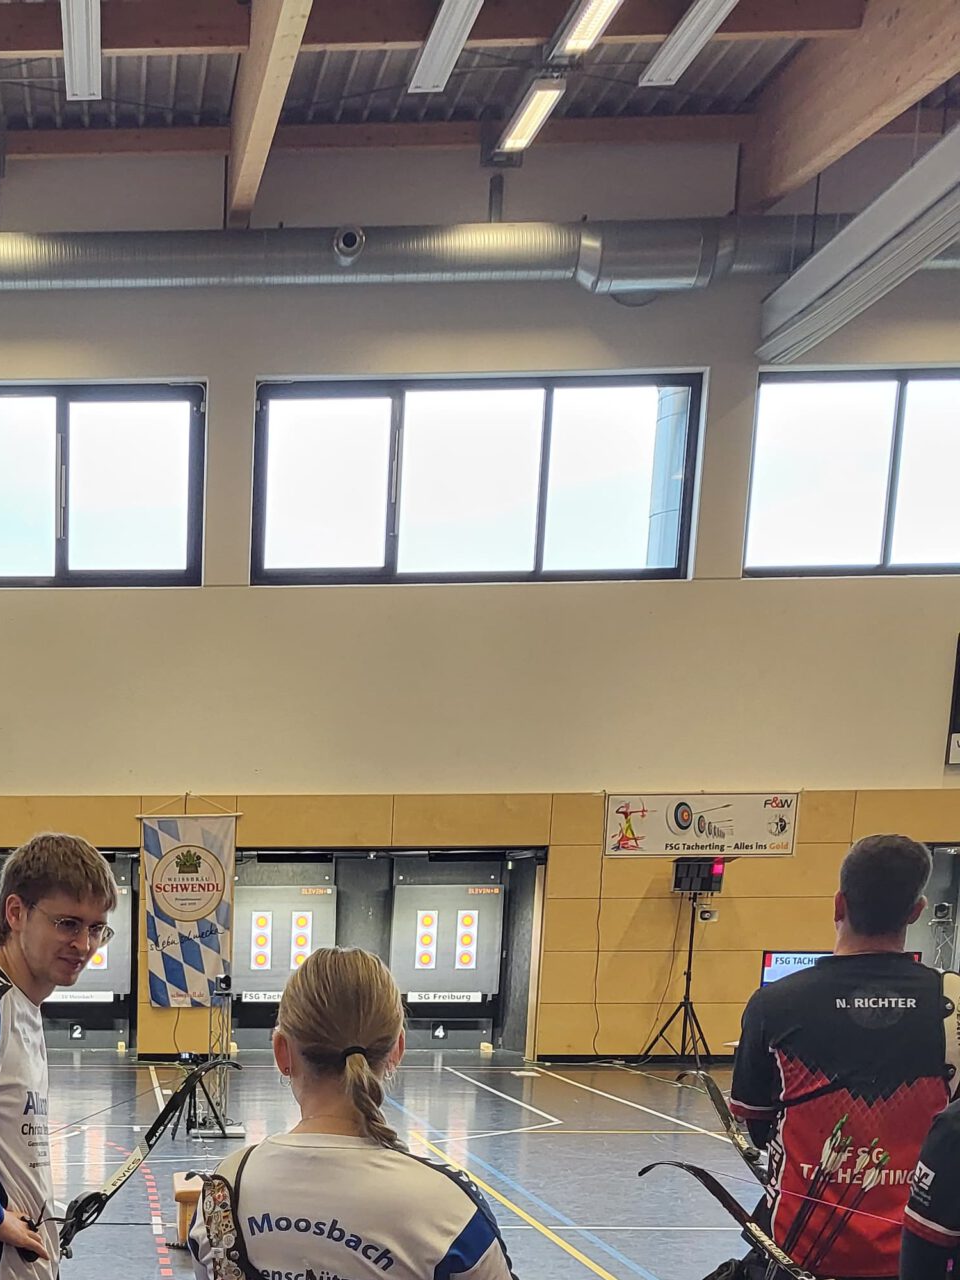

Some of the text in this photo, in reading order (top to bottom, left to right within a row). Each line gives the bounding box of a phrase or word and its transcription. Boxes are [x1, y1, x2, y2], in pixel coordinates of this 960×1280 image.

[763, 796, 793, 809] F&W
[664, 842, 680, 851] FSG
[682, 842, 725, 852] Tacherting
[734, 842, 754, 850] Alles
[755, 842, 767, 850] ins
[769, 842, 789, 850] Gold
[155, 882, 223, 893] SCHWENDL
[775, 957, 791, 965] FSG
[433, 993, 471, 1002] Freiburg
[835, 998, 917, 1009] N. RICHTER
[72, 1024, 82, 1038] 2
[434, 1024, 445, 1038] 4
[111, 1157, 141, 1187] FIVICS
[247, 1212, 395, 1272] Moosbach
